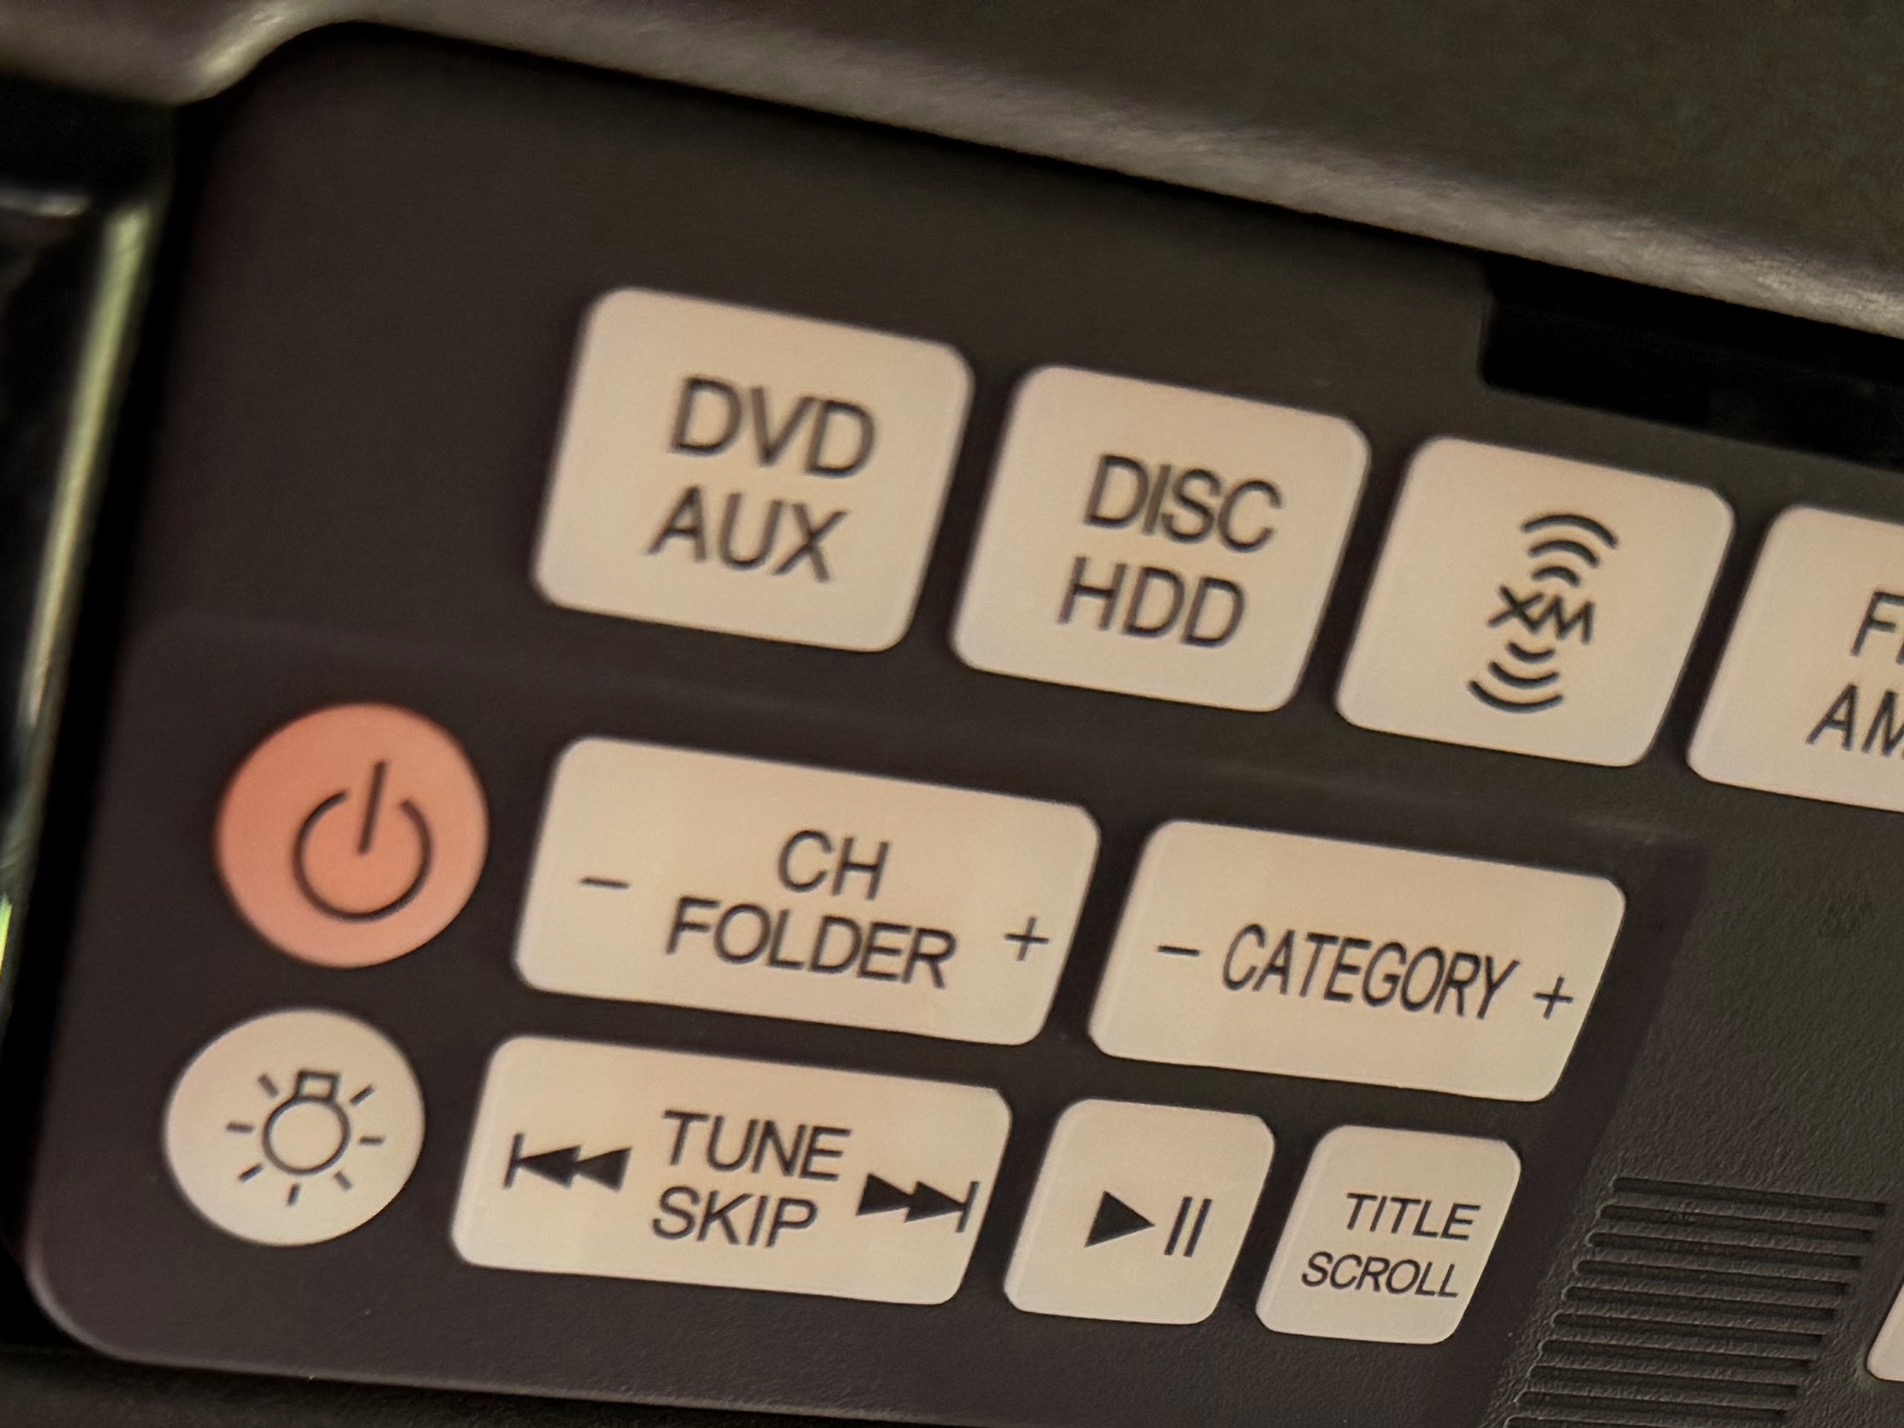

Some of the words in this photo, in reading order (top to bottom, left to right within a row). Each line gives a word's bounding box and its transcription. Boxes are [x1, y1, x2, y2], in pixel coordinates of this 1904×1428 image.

[668, 375, 877, 482] DVD
[647, 487, 848, 585] AUX
[1084, 454, 1282, 555] DISC
[1058, 561, 1248, 652] HDD
[1488, 583, 1597, 646] XM
[775, 827, 890, 901] CH
[663, 899, 958, 989] FOLDER
[1220, 924, 1520, 1022] CATEGORY
[660, 1110, 852, 1183] TUNE
[650, 1186, 820, 1249] SKIP
[1342, 1191, 1481, 1243] TITLE
[1299, 1252, 1461, 1300] SCROLL
